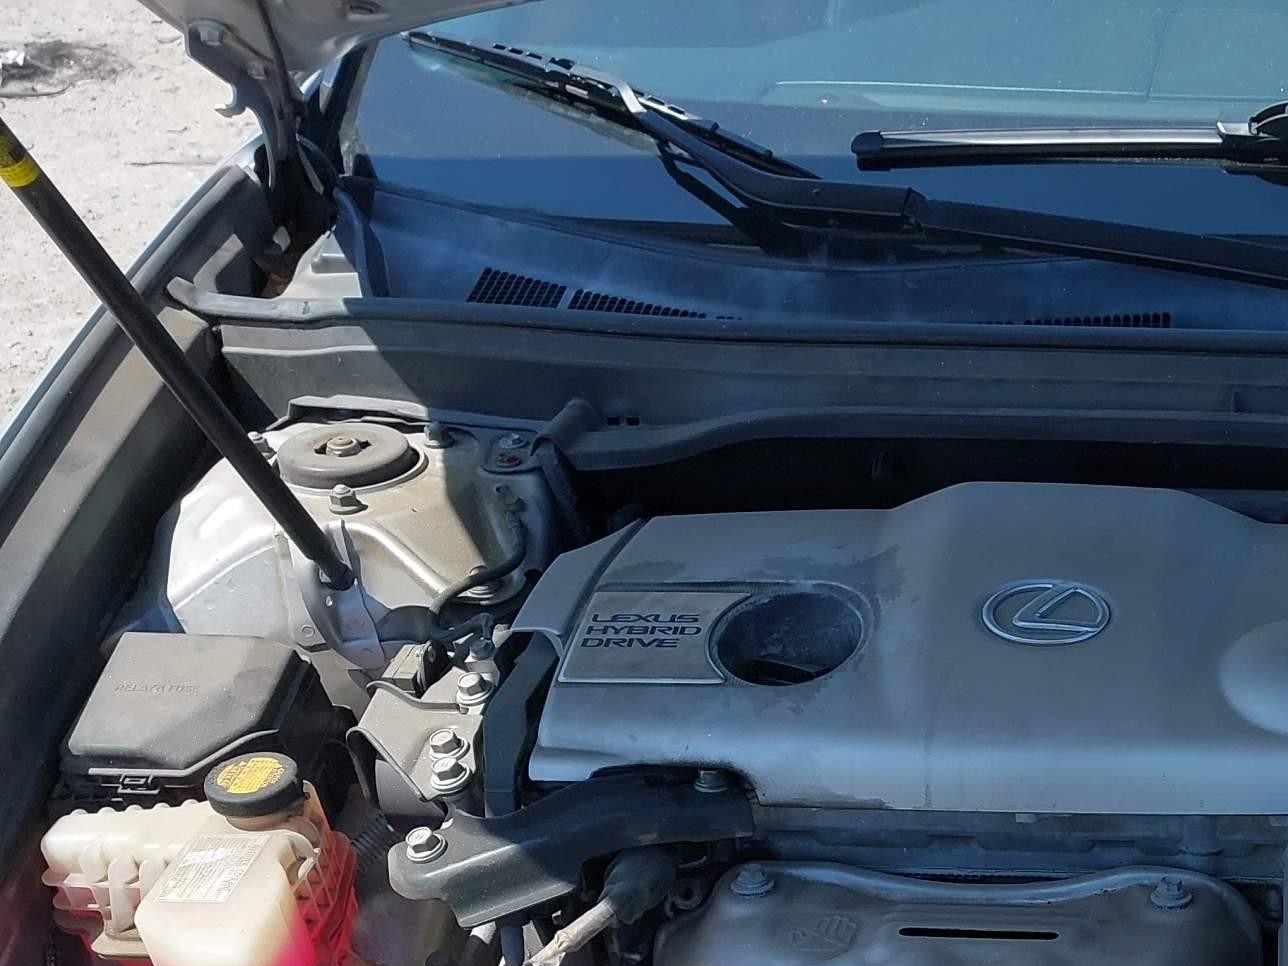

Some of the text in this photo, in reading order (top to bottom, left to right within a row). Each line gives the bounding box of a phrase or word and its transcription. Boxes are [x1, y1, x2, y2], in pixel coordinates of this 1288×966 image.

[591, 613, 700, 623] LEXUS
[586, 625, 702, 636] HYBRID
[581, 637, 681, 648] DRIVE
